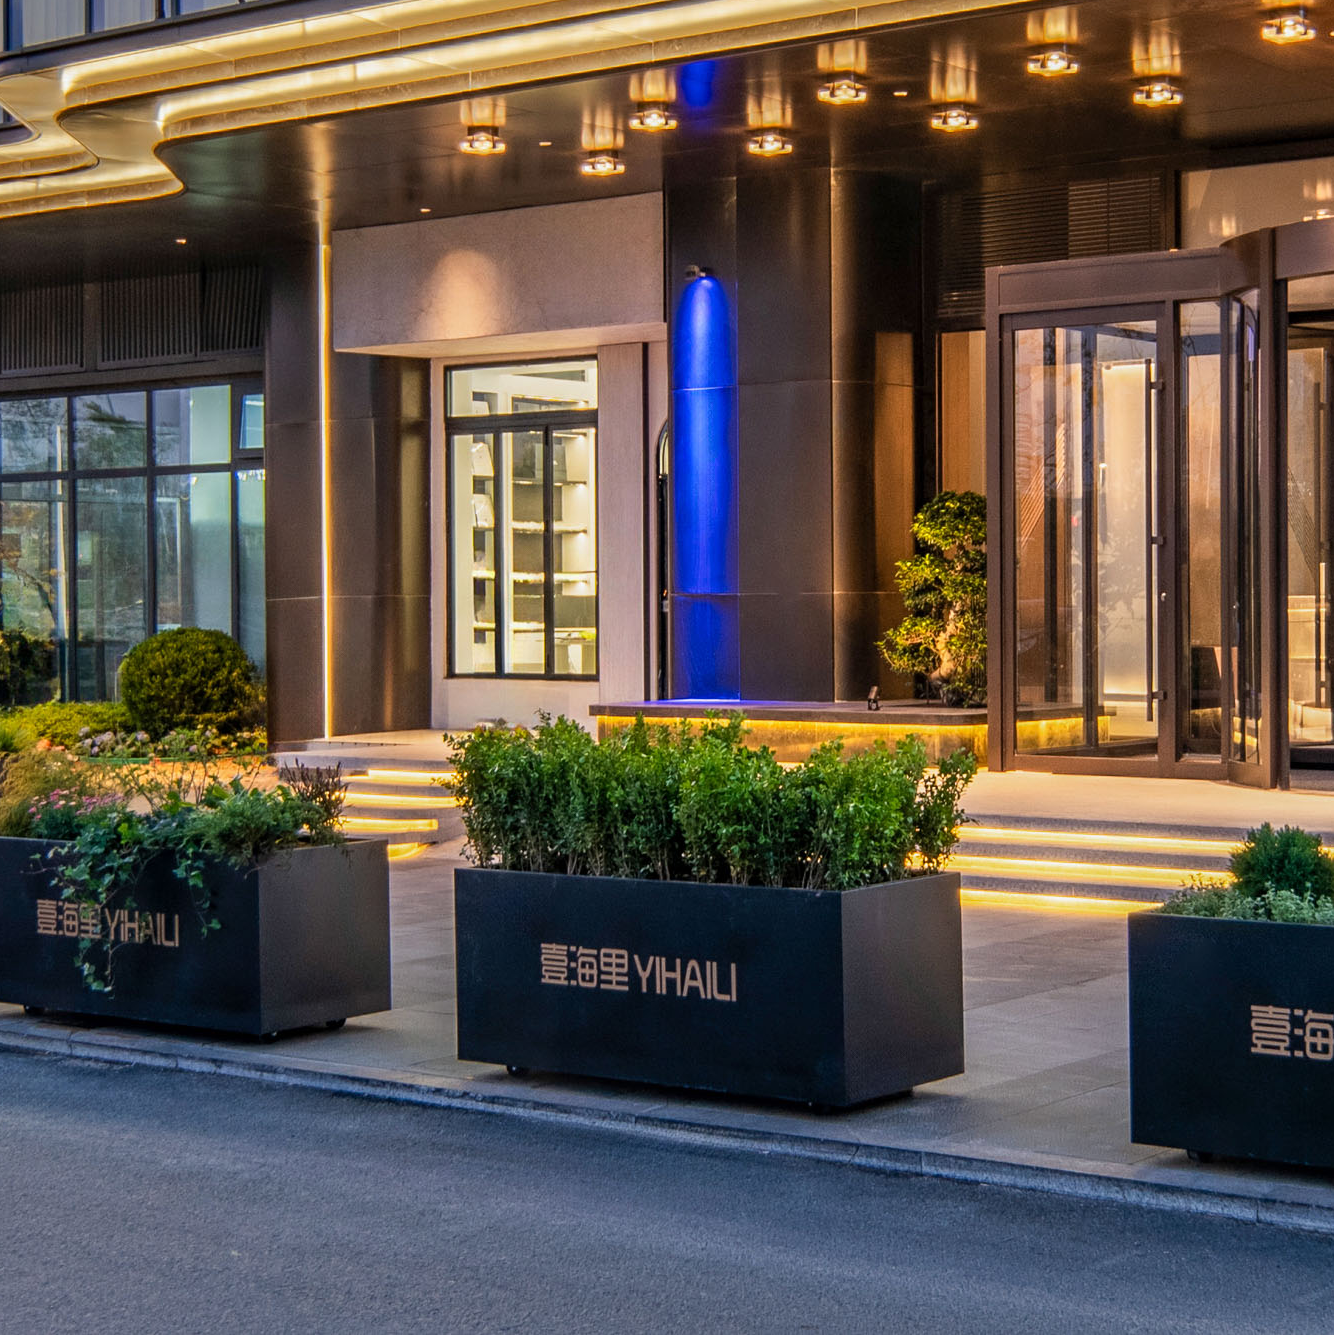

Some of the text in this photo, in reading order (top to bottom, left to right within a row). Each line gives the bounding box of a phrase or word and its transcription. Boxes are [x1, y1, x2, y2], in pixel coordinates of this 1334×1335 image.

[104, 908, 180, 948] YIHAILI
[540, 942, 738, 1002] 壹海里 YIHAILI
